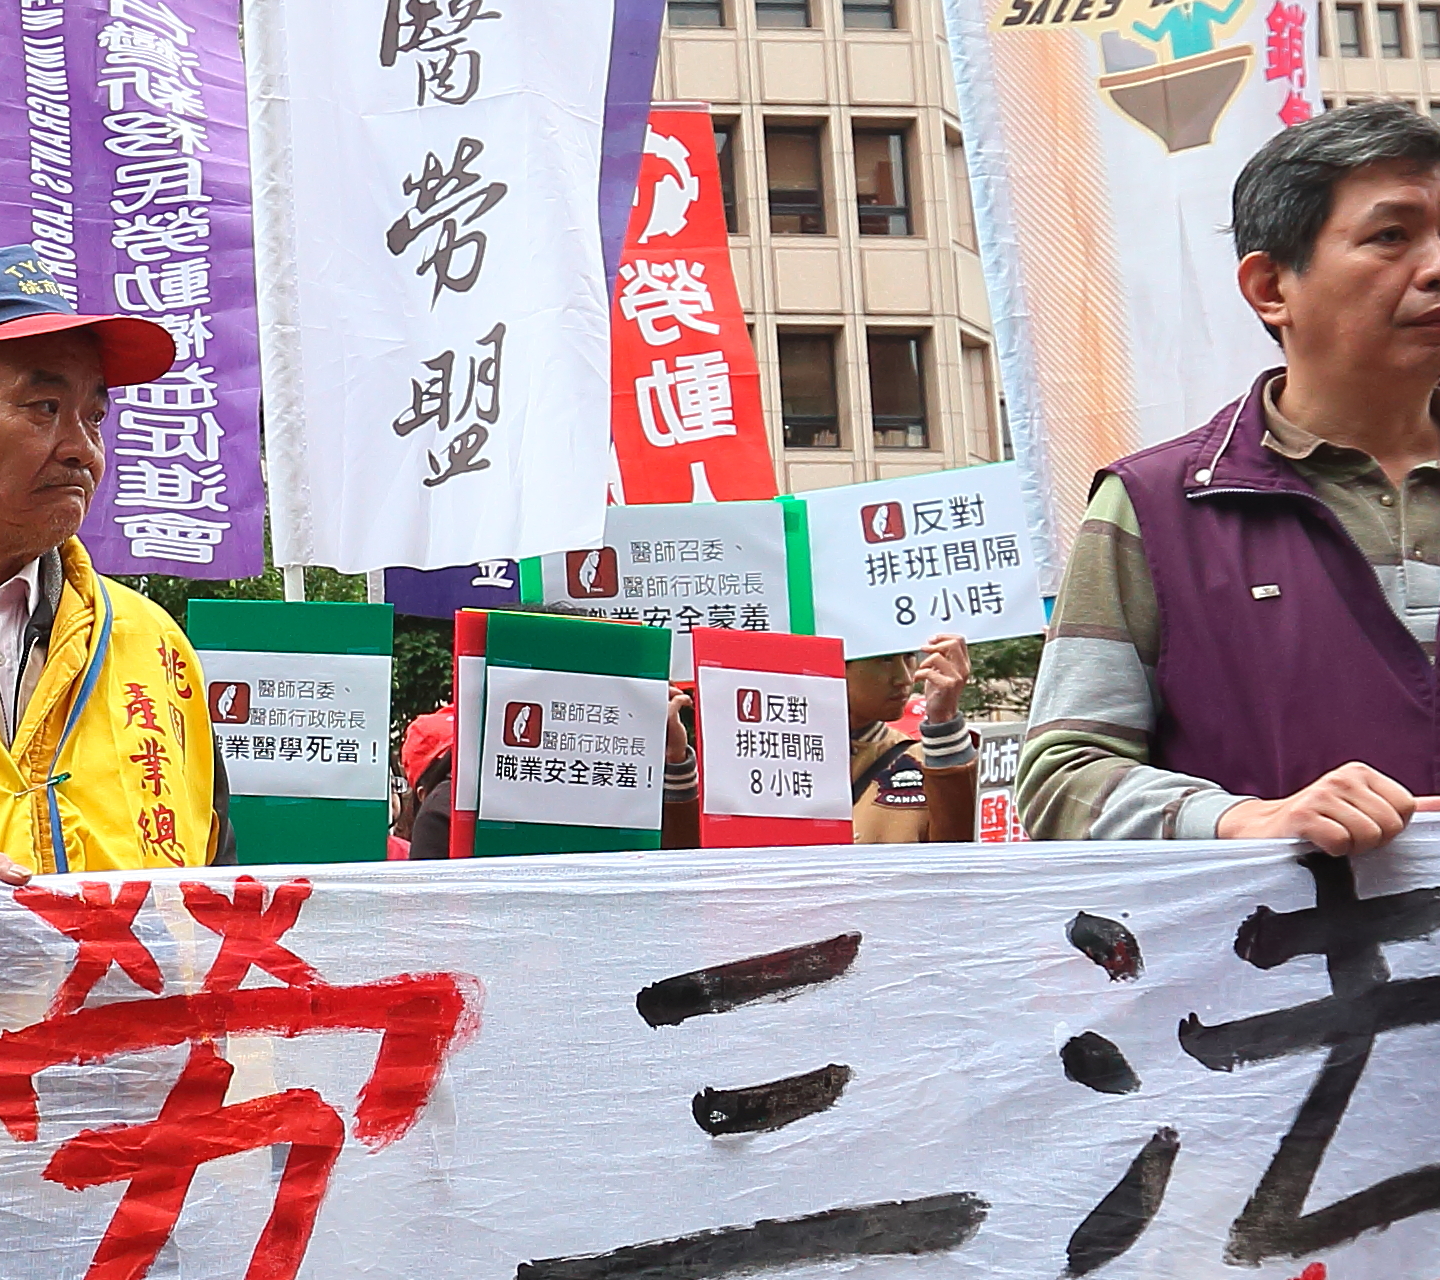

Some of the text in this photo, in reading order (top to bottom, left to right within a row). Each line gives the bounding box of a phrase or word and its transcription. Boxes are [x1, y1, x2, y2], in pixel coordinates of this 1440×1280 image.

[912, 492, 985, 536] 反對
[865, 534, 1020, 587] 排班間隔
[623, 572, 765, 600] 醫師行政院長
[249, 707, 366, 729] 醫師行政院長
[765, 694, 809, 724] 反對
[541, 730, 646, 757] 醫師行政院長
[735, 730, 825, 762] 排班間隔
[123, 682, 185, 867] 產業總
